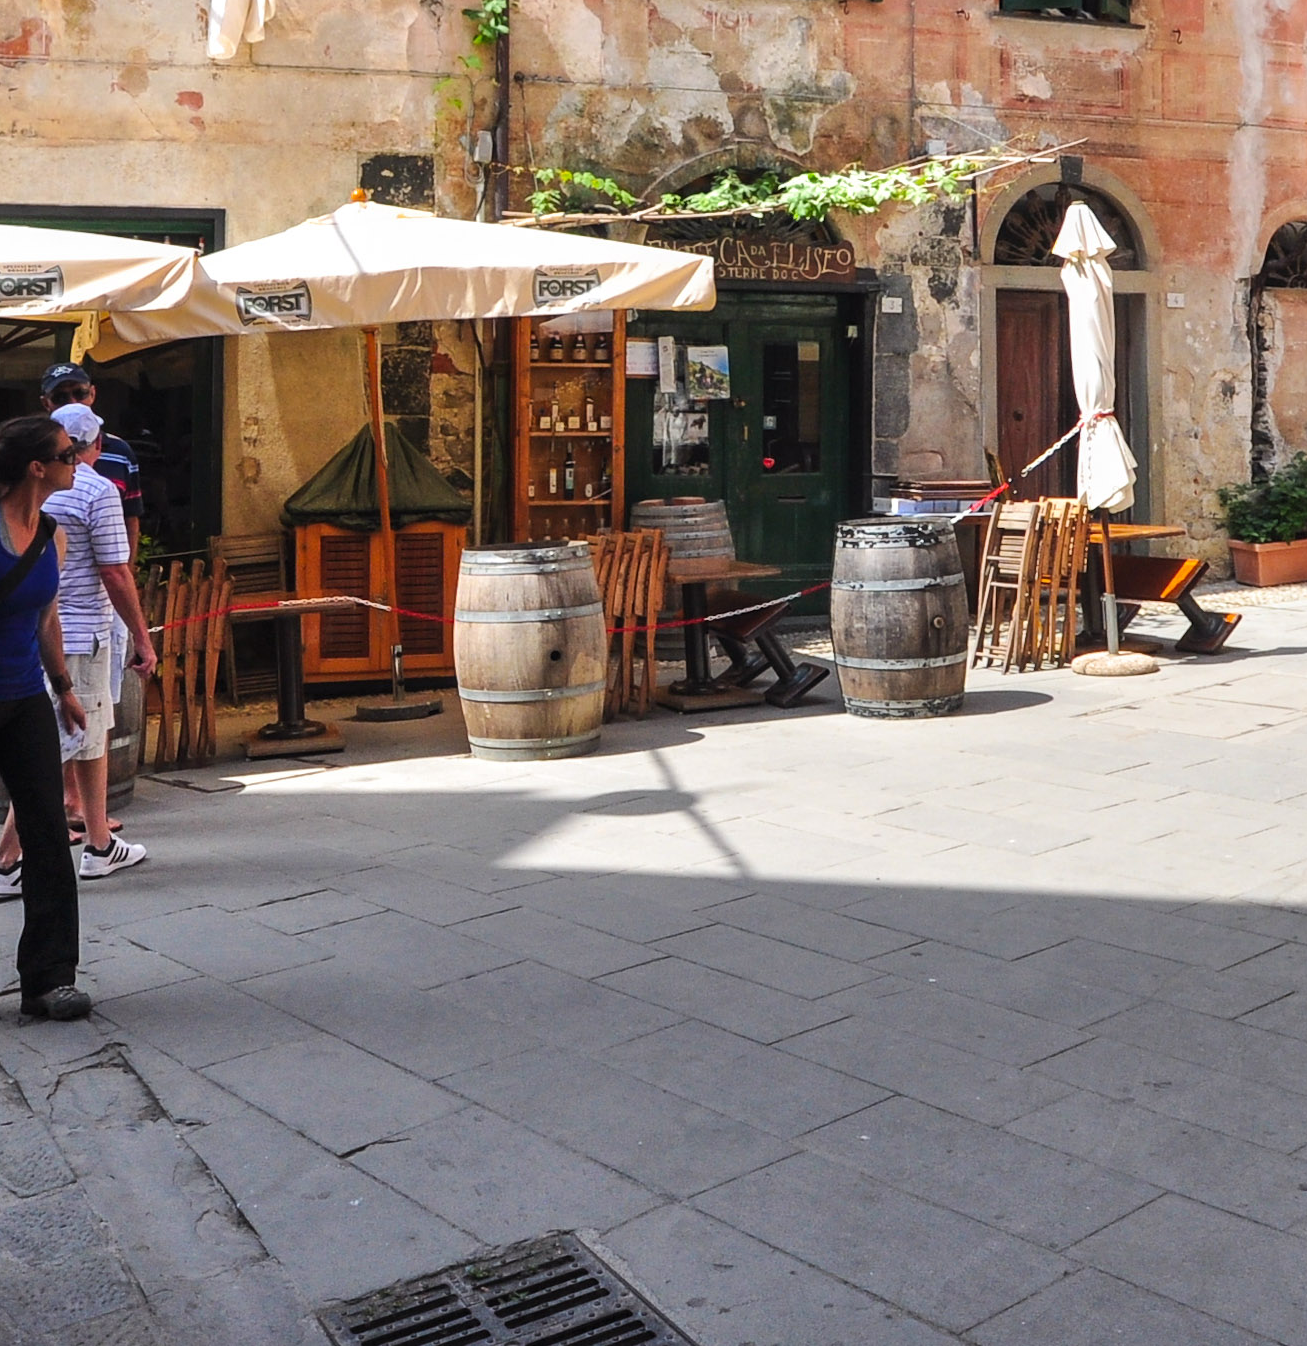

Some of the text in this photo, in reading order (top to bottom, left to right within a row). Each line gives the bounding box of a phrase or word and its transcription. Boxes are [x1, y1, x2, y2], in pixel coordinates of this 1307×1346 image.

[750, 245, 767, 256] DA
[538, 280, 596, 297] FORST
[243, 293, 305, 315] FORST
